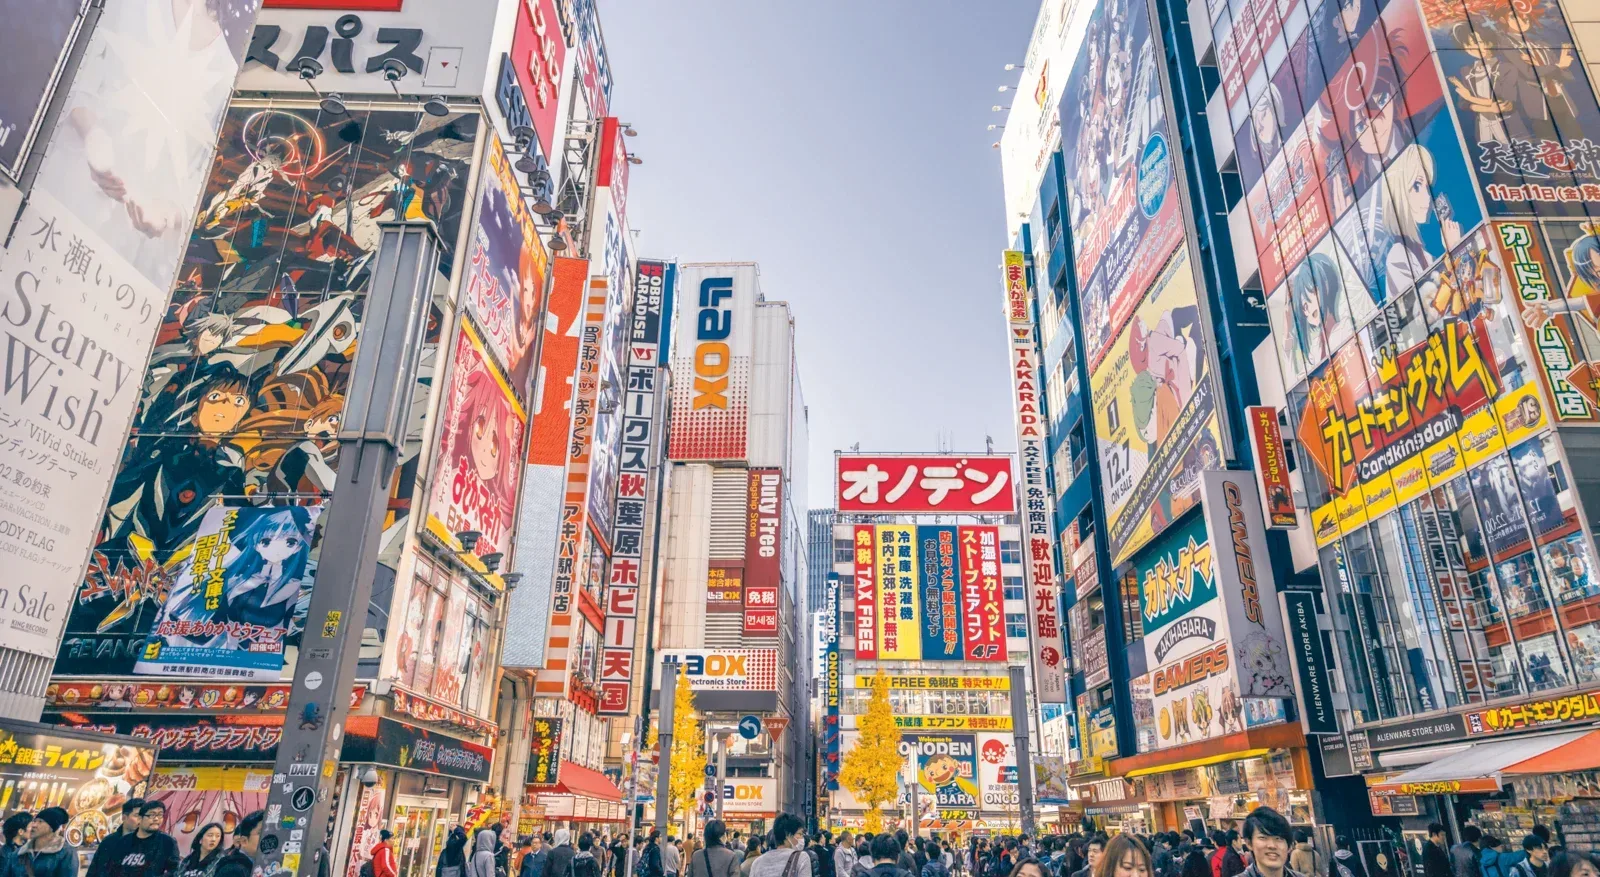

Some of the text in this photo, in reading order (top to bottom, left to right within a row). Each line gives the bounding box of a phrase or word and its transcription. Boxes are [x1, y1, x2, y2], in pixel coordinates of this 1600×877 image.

[31, 217, 152, 325] 水瀬いのり
[649, 265, 663, 315] HOBBY
[1007, 266, 1027, 318] まんが喫茶
[24, 249, 142, 346] New Single
[633, 264, 651, 339] PARADISE
[1498, 224, 1591, 419] カードゲム専門店
[1, 270, 135, 407] Starry
[580, 326, 600, 372] 買取り
[4, 331, 103, 447] Wish
[1015, 348, 1038, 436] TAKARADA
[1322, 319, 1499, 492] カードキングダム
[571, 399, 589, 457] まっくす
[1261, 418, 1280, 483] カードキングダム
[841, 459, 1008, 506] オノデン
[1106, 443, 1129, 488] 12.7
[750, 474, 760, 537] Flagship Store
[1026, 487, 1047, 534] 免税商店
[1112, 476, 1132, 505] ON SALE
[758, 474, 780, 557] Duty Free
[25, 530, 55, 552] FLAG
[204, 509, 239, 611] スニーカー文庫は
[552, 505, 579, 611] アキバ駅前店
[1222, 480, 1265, 630] GAMERS
[708, 569, 725, 578] 本店
[748, 591, 775, 604] 免税
[856, 530, 874, 652] 免税 TAX FREE
[898, 531, 914, 621] 冷蔵庫 洗濯機
[924, 539, 941, 635] お見積り無料です
[11, 619, 48, 635] KING RECORDS
[12, 584, 55, 622] Sale
[747, 615, 775, 626] 면세점
[828, 579, 838, 643] Panasonic
[155, 621, 287, 641] 応援ありがとうフェア
[250, 642, 281, 653] 開催中!!
[971, 645, 999, 657] 4F
[1160, 619, 1209, 658] AKIHABARA
[727, 678, 747, 686] Store
[829, 652, 838, 707] ONODEN
[892, 677, 926, 687] FREE
[929, 677, 959, 687] 免税店
[1153, 645, 1230, 698] GAMERS
[1296, 602, 1325, 723] ALIENWARE STORE AKIBA
[895, 717, 923, 727] 冷蔵庫
[927, 718, 965, 727] エアコン
[1377, 729, 1412, 742] ALIENWARE
[1412, 726, 1433, 737] STORE
[1434, 723, 1456, 735] AKIBA
[1500, 694, 1600, 731] カードキングダム
[15, 745, 105, 769] 銀座ライオン
[290, 765, 317, 776] DAVE
[900, 742, 972, 755] ONODEN
[1408, 782, 1452, 794] カードキングダム
